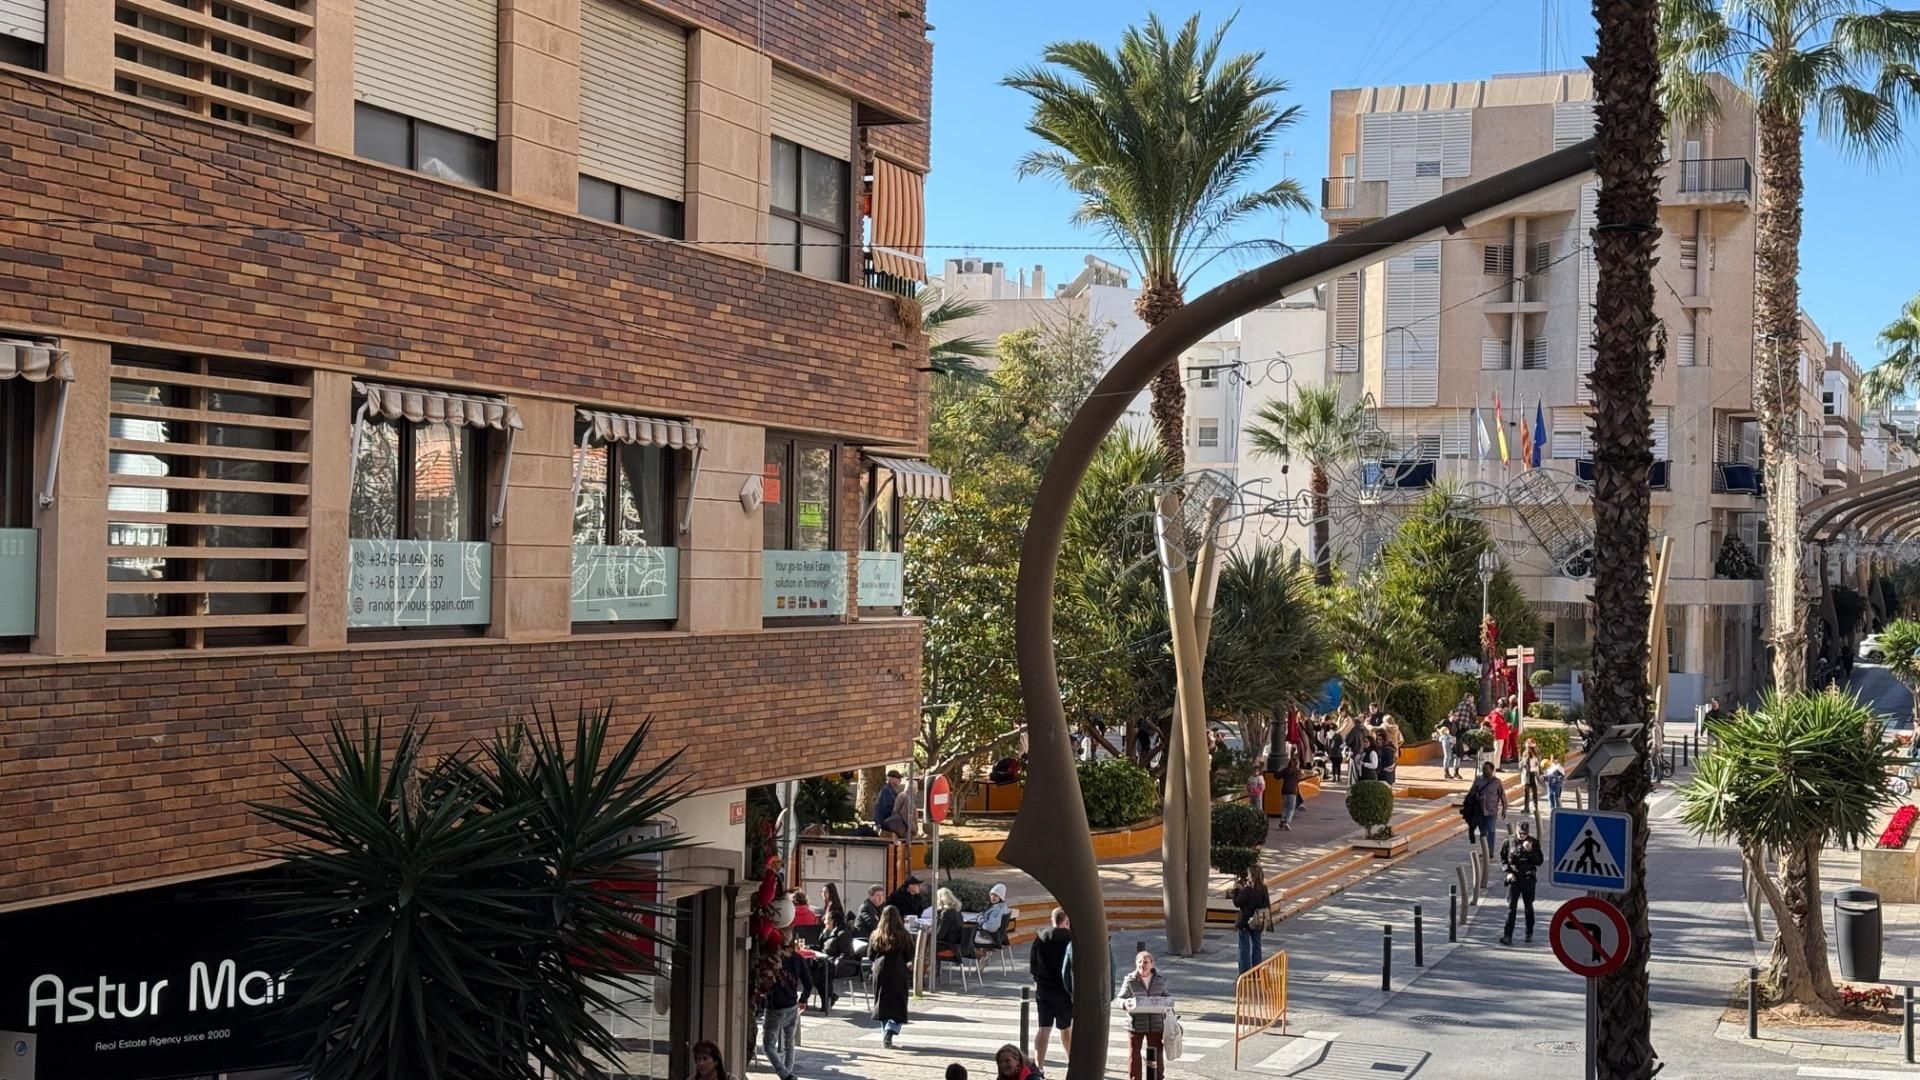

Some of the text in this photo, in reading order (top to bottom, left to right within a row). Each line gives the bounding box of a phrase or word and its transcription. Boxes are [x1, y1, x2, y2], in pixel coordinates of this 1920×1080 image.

[369, 553, 386, 567] +34
[428, 554, 444, 567] 36
[775, 561, 787, 571] Your
[803, 561, 814, 571] Real
[815, 561, 830, 571] Estate
[369, 576, 386, 589] +34
[388, 576, 406, 589] 61
[775, 577, 796, 588] solution
[797, 578, 803, 588] in
[368, 597, 474, 613] randomhousspain.com
[28, 958, 294, 1026] Astur Mar
[95, 1029, 230, 1051] Real Estate Agency since 2000
